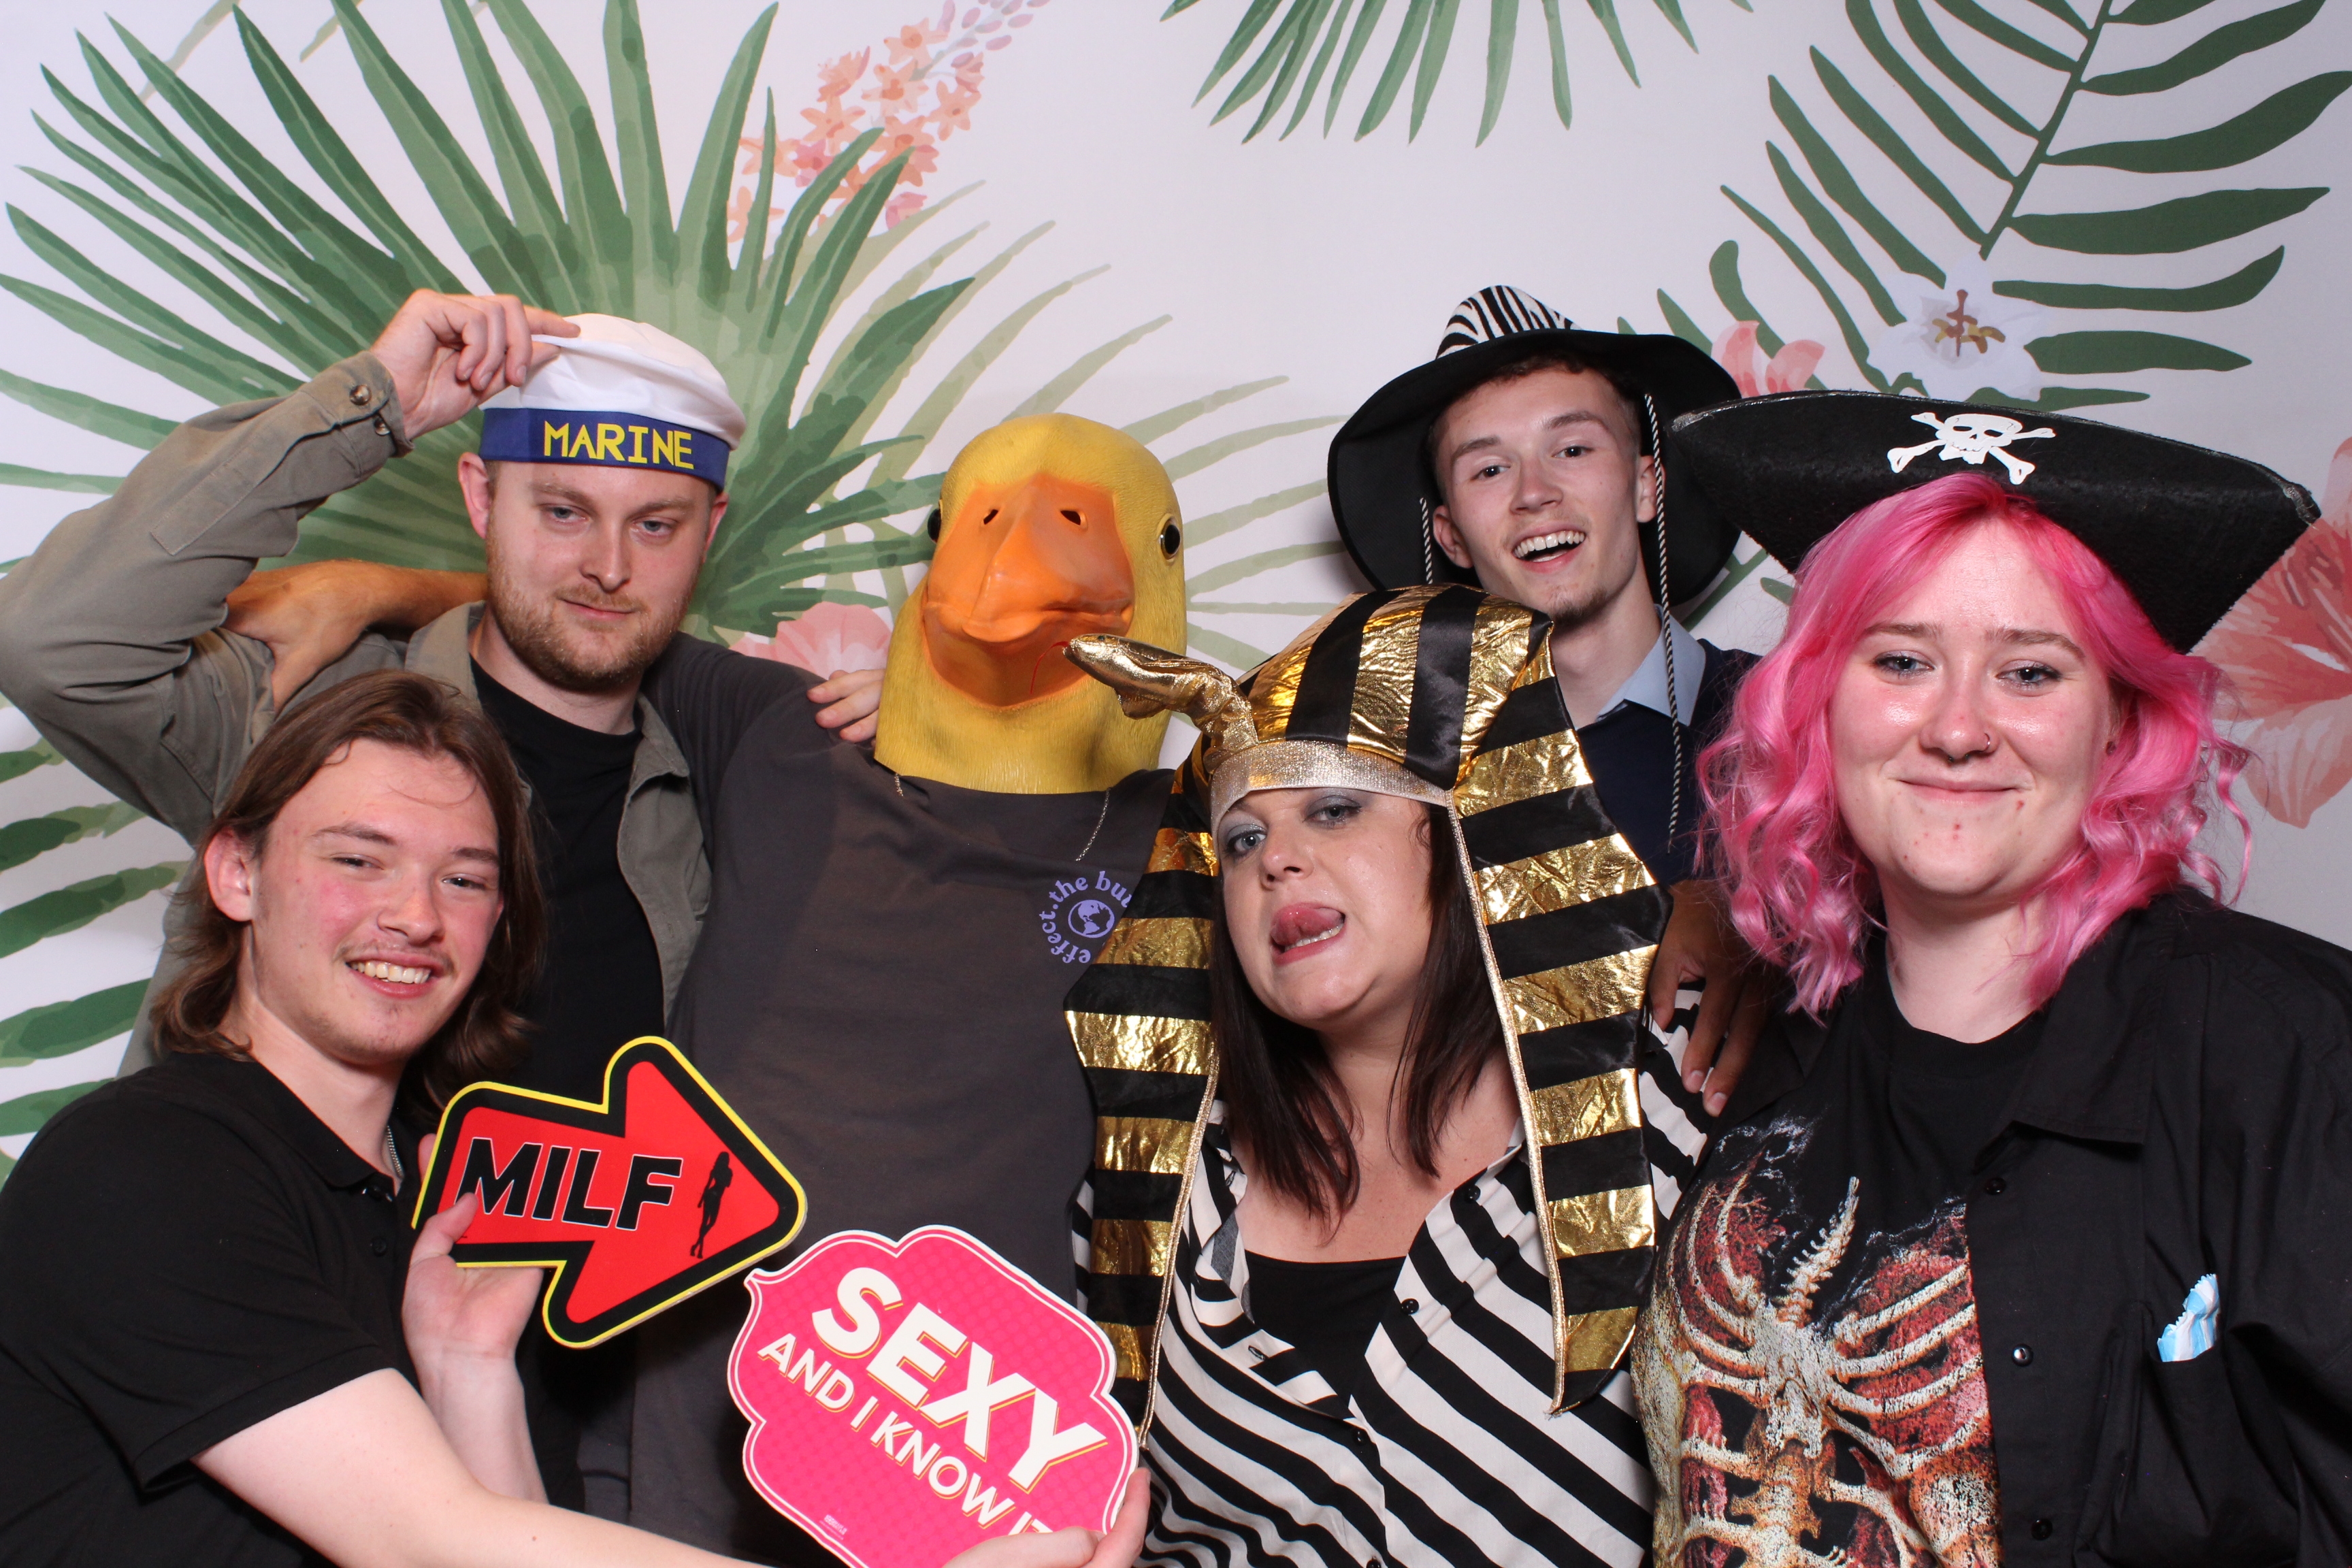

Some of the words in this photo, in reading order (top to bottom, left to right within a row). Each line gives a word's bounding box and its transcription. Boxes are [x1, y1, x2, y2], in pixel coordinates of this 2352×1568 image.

[544, 420, 695, 470] MARINE
[1048, 877, 1089, 902] the
[454, 1137, 683, 1231] MILF
[811, 1267, 1108, 1494] SEXY
[757, 1333, 855, 1413] AND
[850, 1395, 879, 1432] I
[870, 1411, 1016, 1530] KNOW
